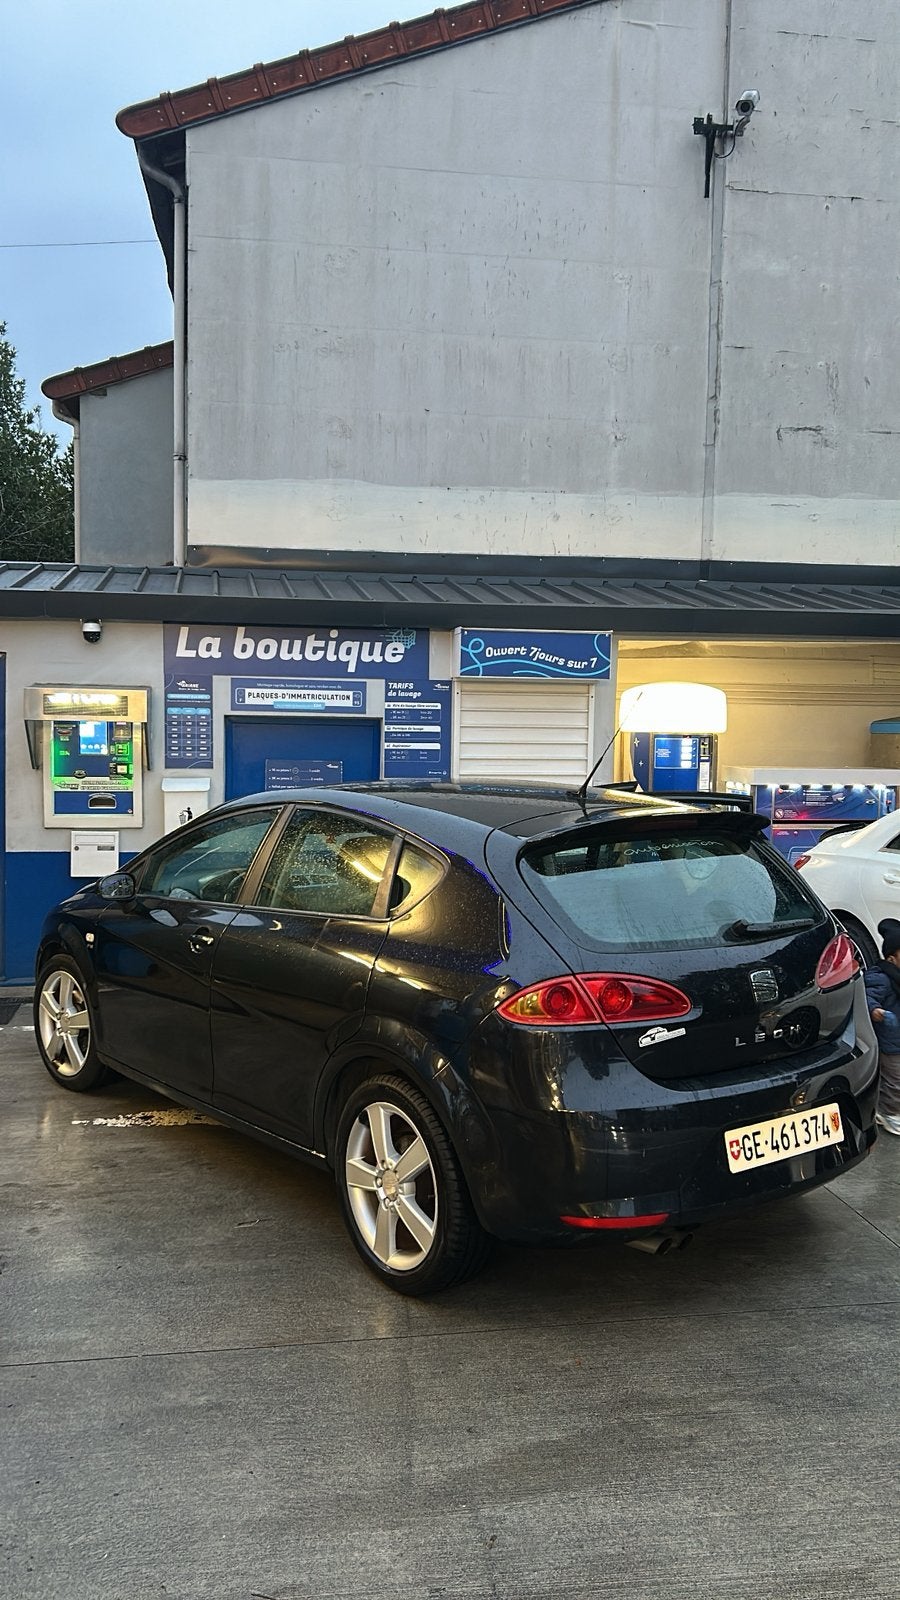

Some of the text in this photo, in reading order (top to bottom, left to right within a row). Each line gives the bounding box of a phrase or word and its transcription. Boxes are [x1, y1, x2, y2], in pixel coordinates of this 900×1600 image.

[175, 626, 405, 673] La boutique
[485, 645, 598, 669] Ouvert 7jours sur 7
[247, 692, 351, 701] PLAQUES-D'IMMATRICULATION
[388, 682, 414, 690] TARIFS
[735, 1024, 800, 1047] LEON
